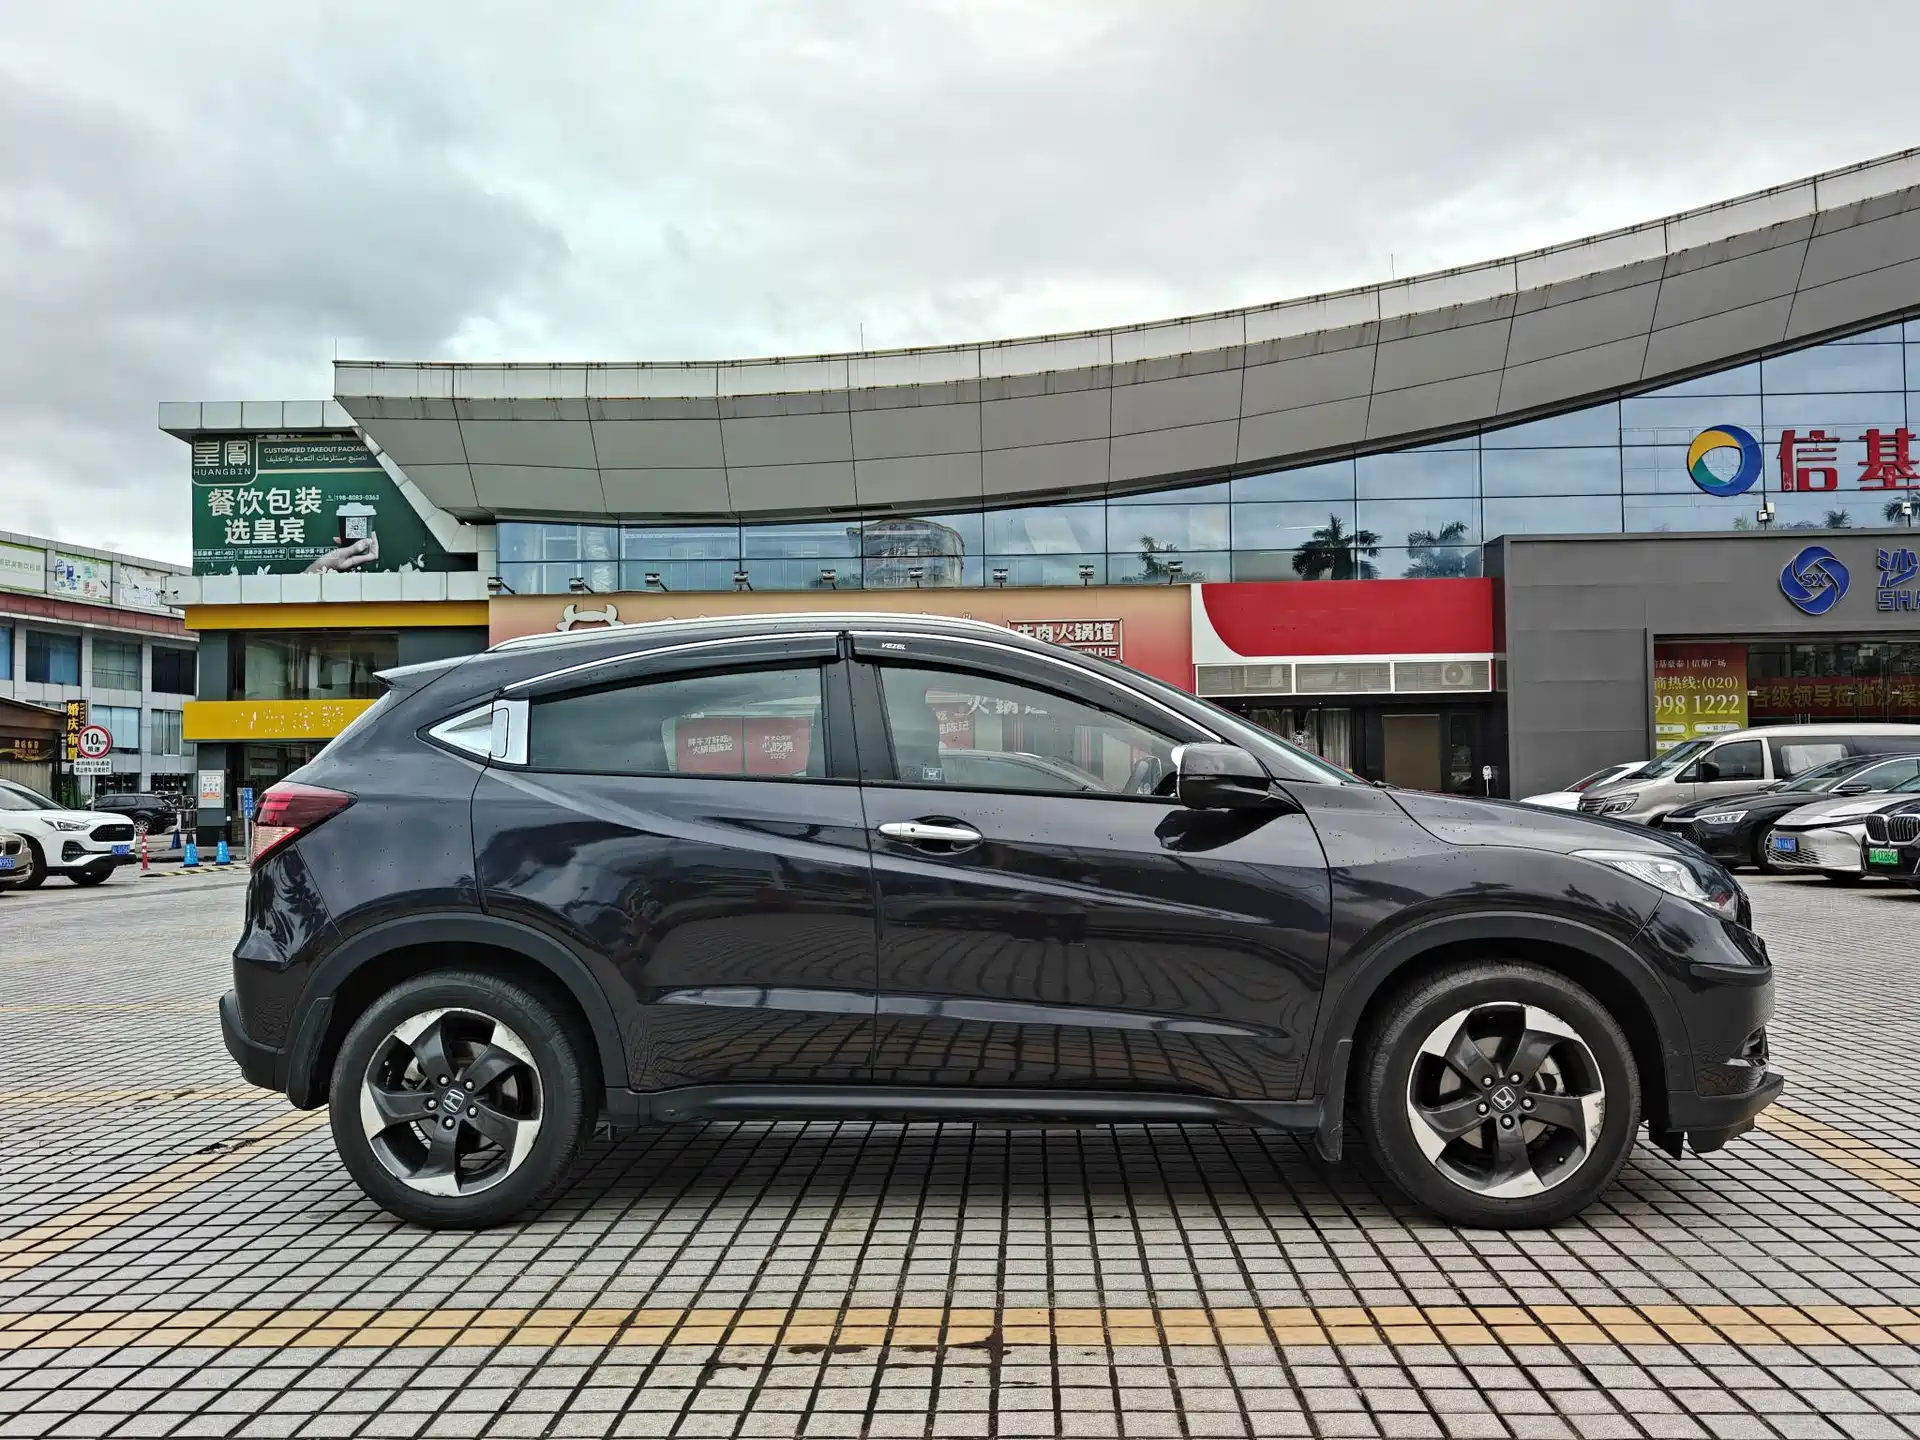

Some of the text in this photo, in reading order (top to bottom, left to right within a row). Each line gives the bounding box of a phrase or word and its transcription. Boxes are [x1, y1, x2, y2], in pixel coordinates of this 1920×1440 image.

[263, 446, 306, 455] CUSTOMIZED
[307, 445, 338, 453] TAKEOUT
[1776, 428, 1920, 492] 信基
[194, 467, 251, 476] HUANGBIN
[207, 486, 323, 517] 餐饮包装
[224, 516, 306, 545] 选皇宾
[1802, 572, 1828, 587] SX
[1016, 623, 1115, 642] 牛肉火锅馆
[881, 642, 906, 650] VEZEL
[1098, 647, 1117, 657] HE
[1693, 694, 1740, 714] 1222
[1750, 684, 1920, 709] 各级领导莅临沙溪
[84, 733, 99, 745] 10
